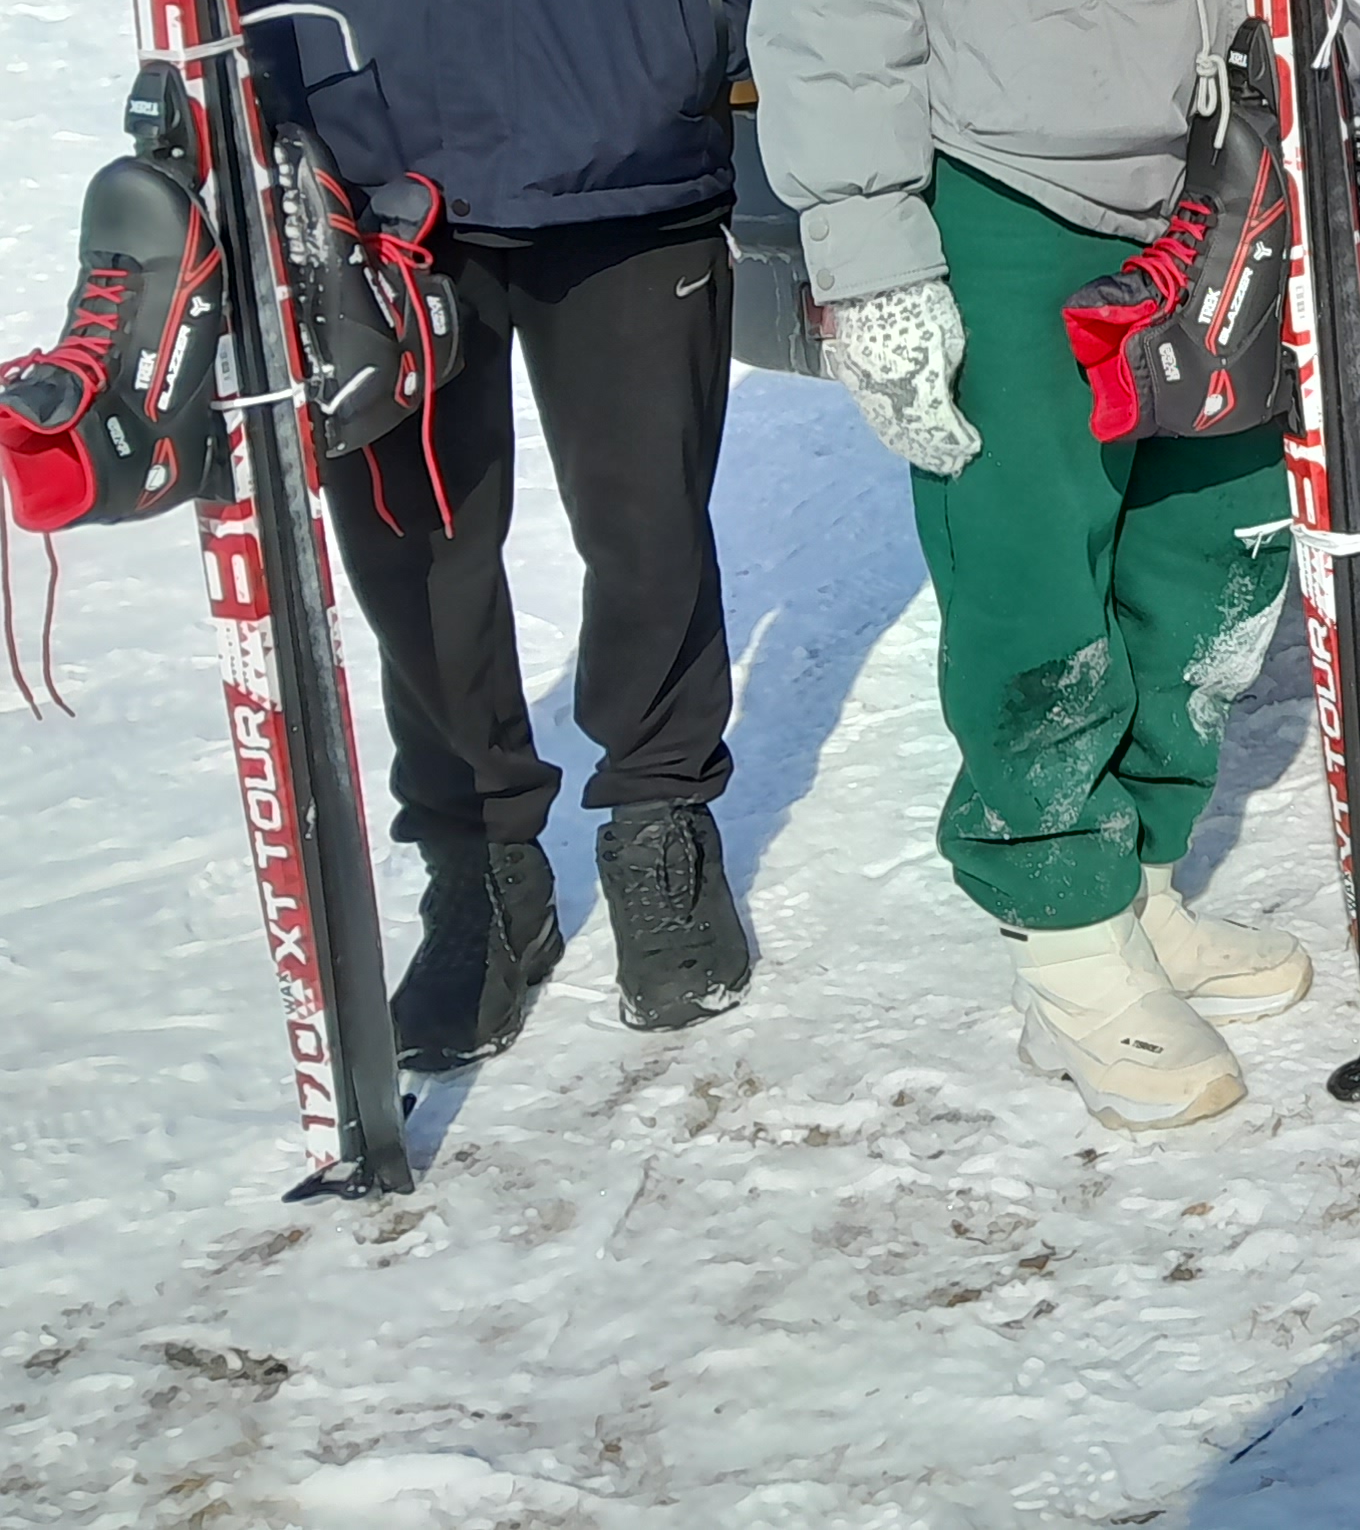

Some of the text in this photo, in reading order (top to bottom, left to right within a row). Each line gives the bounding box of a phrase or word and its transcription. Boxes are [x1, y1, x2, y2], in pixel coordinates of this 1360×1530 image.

[129, 100, 159, 116] TREK
[1198, 287, 1222, 324] TREK
[1218, 267, 1253, 346] BLAZZER
[134, 349, 157, 390] TREK
[158, 324, 191, 411] BLAZZER
[1308, 616, 1346, 772] TOUR
[233, 704, 336, 1131] 170 WAX XT TOUR
